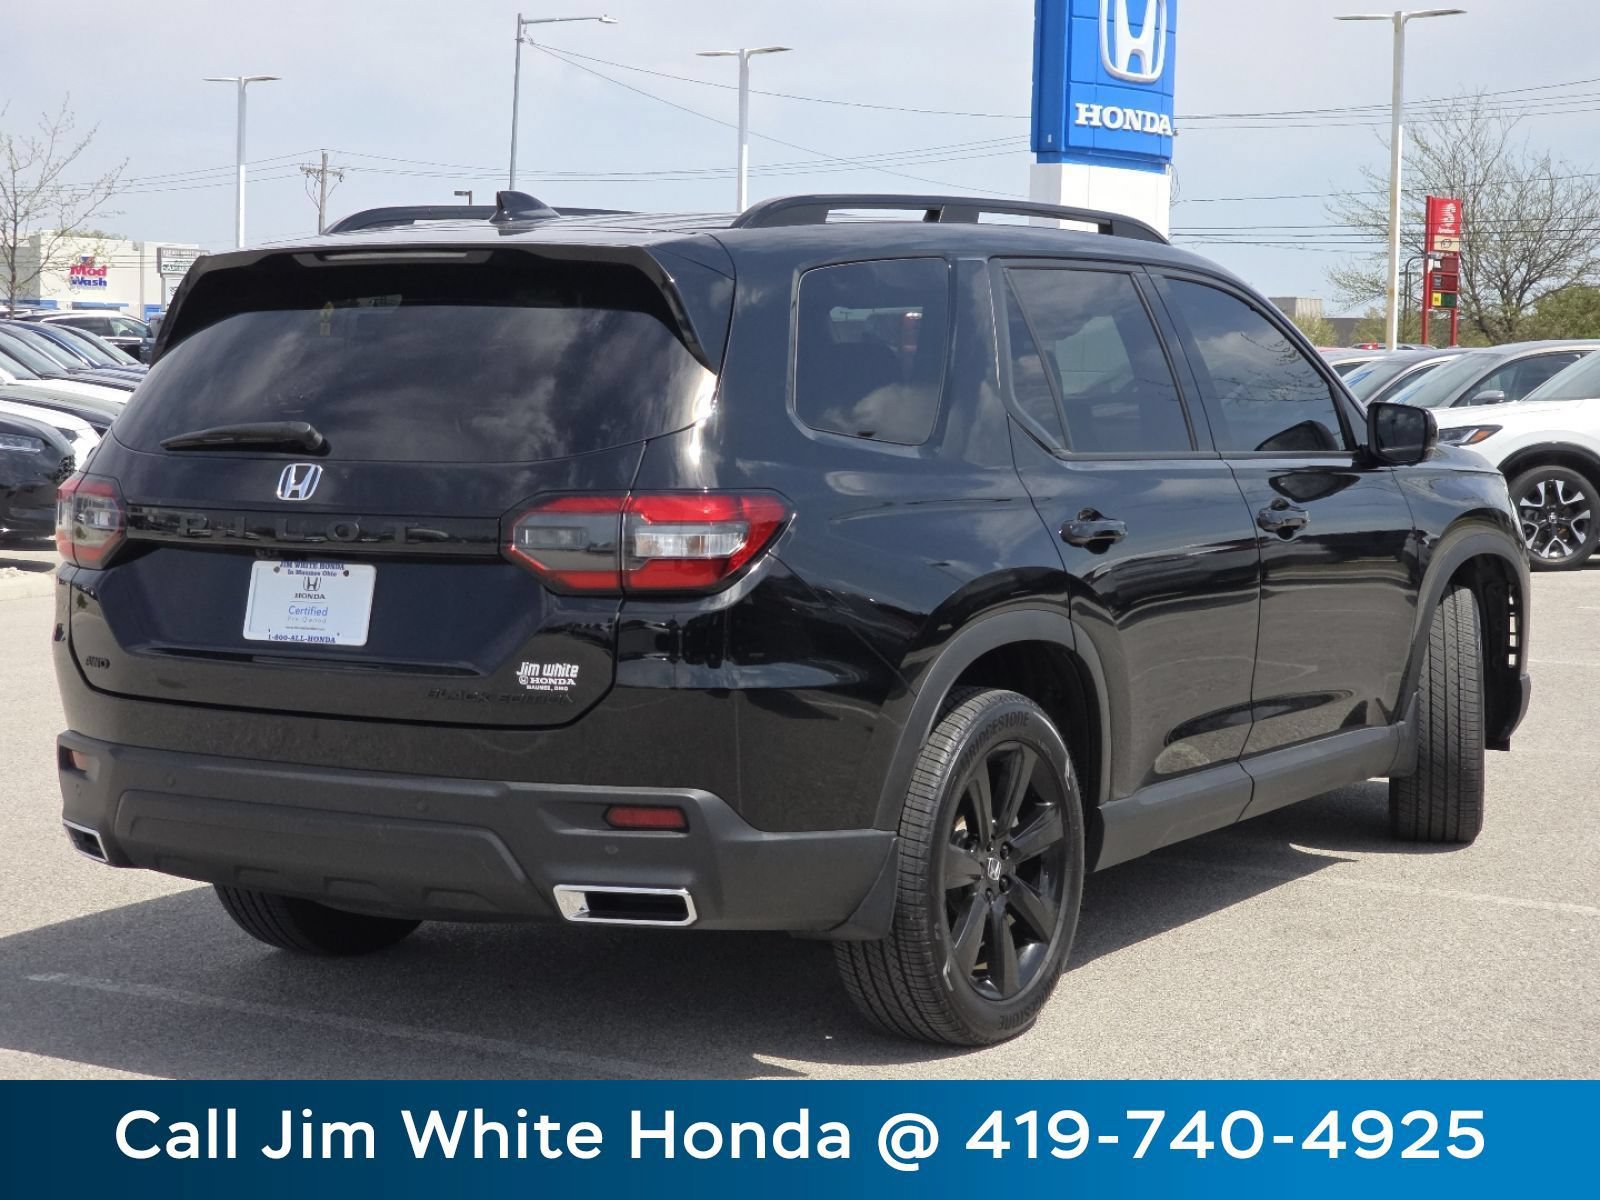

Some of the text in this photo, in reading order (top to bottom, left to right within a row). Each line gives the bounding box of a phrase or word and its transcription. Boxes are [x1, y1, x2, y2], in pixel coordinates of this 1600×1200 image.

[1074, 103, 1173, 136] HONDA
[70, 264, 107, 276] Mod
[70, 276, 107, 287] Wash
[178, 516, 418, 543] PILOT
[280, 560, 293, 568] JIM
[320, 562, 345, 570] HONDA
[294, 592, 326, 600] HONDA
[288, 605, 329, 617] Certified
[268, 634, 336, 644] 1-800-ALL-HONDA
[85, 656, 110, 669] AWD
[516, 662, 540, 677] Jim
[530, 677, 576, 686] HONDA
[961, 711, 1030, 769] BRIDGESTONE
